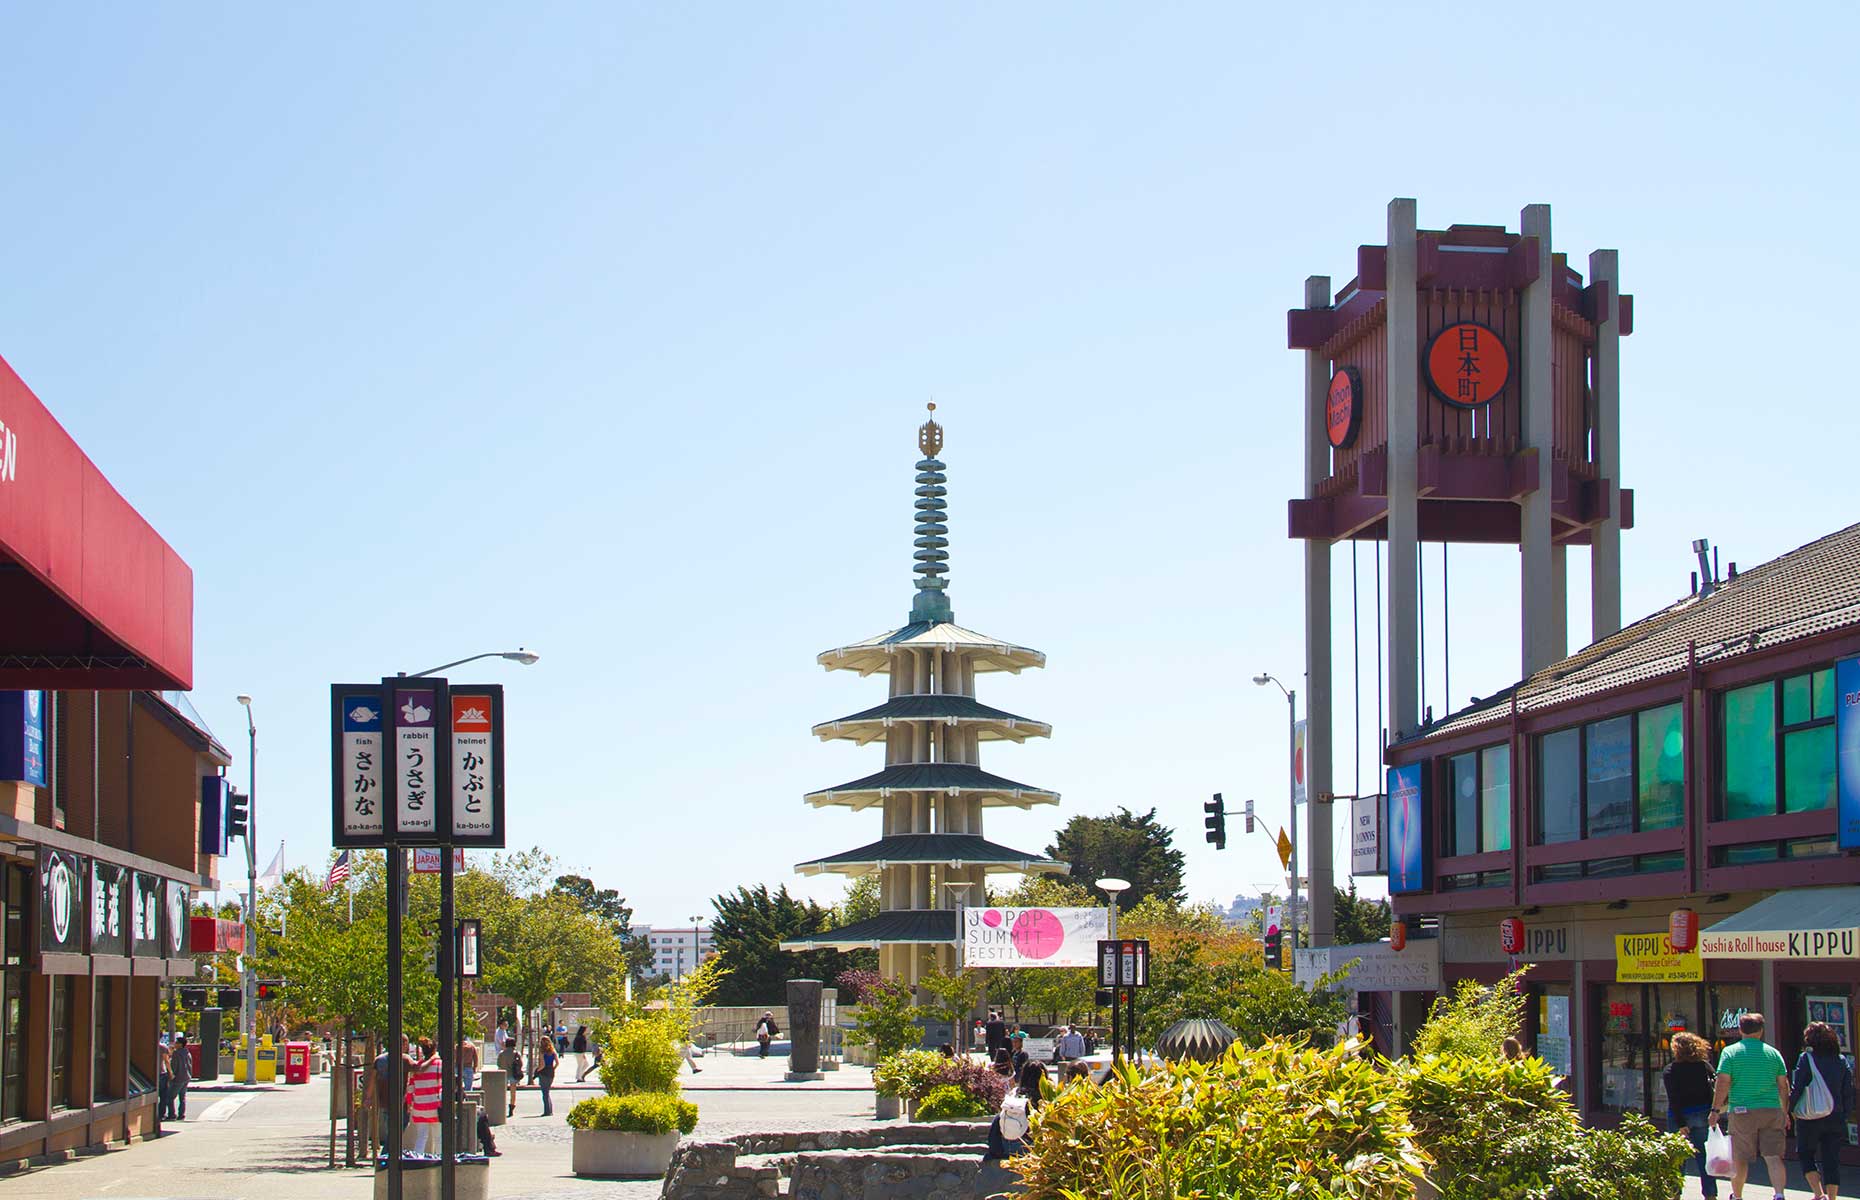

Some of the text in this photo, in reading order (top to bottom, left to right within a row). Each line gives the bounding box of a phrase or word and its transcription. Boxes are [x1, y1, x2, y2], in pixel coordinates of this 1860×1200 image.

[1457, 328, 1481, 402] 日本町
[403, 732, 429, 740] rabbit
[355, 751, 376, 816] さかな
[406, 748, 427, 811] うさぎ
[462, 751, 484, 813] かぶと
[417, 854, 461, 864] JAPANN
[1005, 910, 1044, 927] POP
[969, 929, 1044, 945] SUMMIT
[1526, 927, 1567, 954] IPPU
[1623, 937, 1659, 956] KIPPU
[1755, 936, 1786, 952] house
[1788, 930, 1853, 956] KIPPU
[969, 946, 1044, 960] FESTIVAL
[1720, 1006, 1748, 1029] Asa
